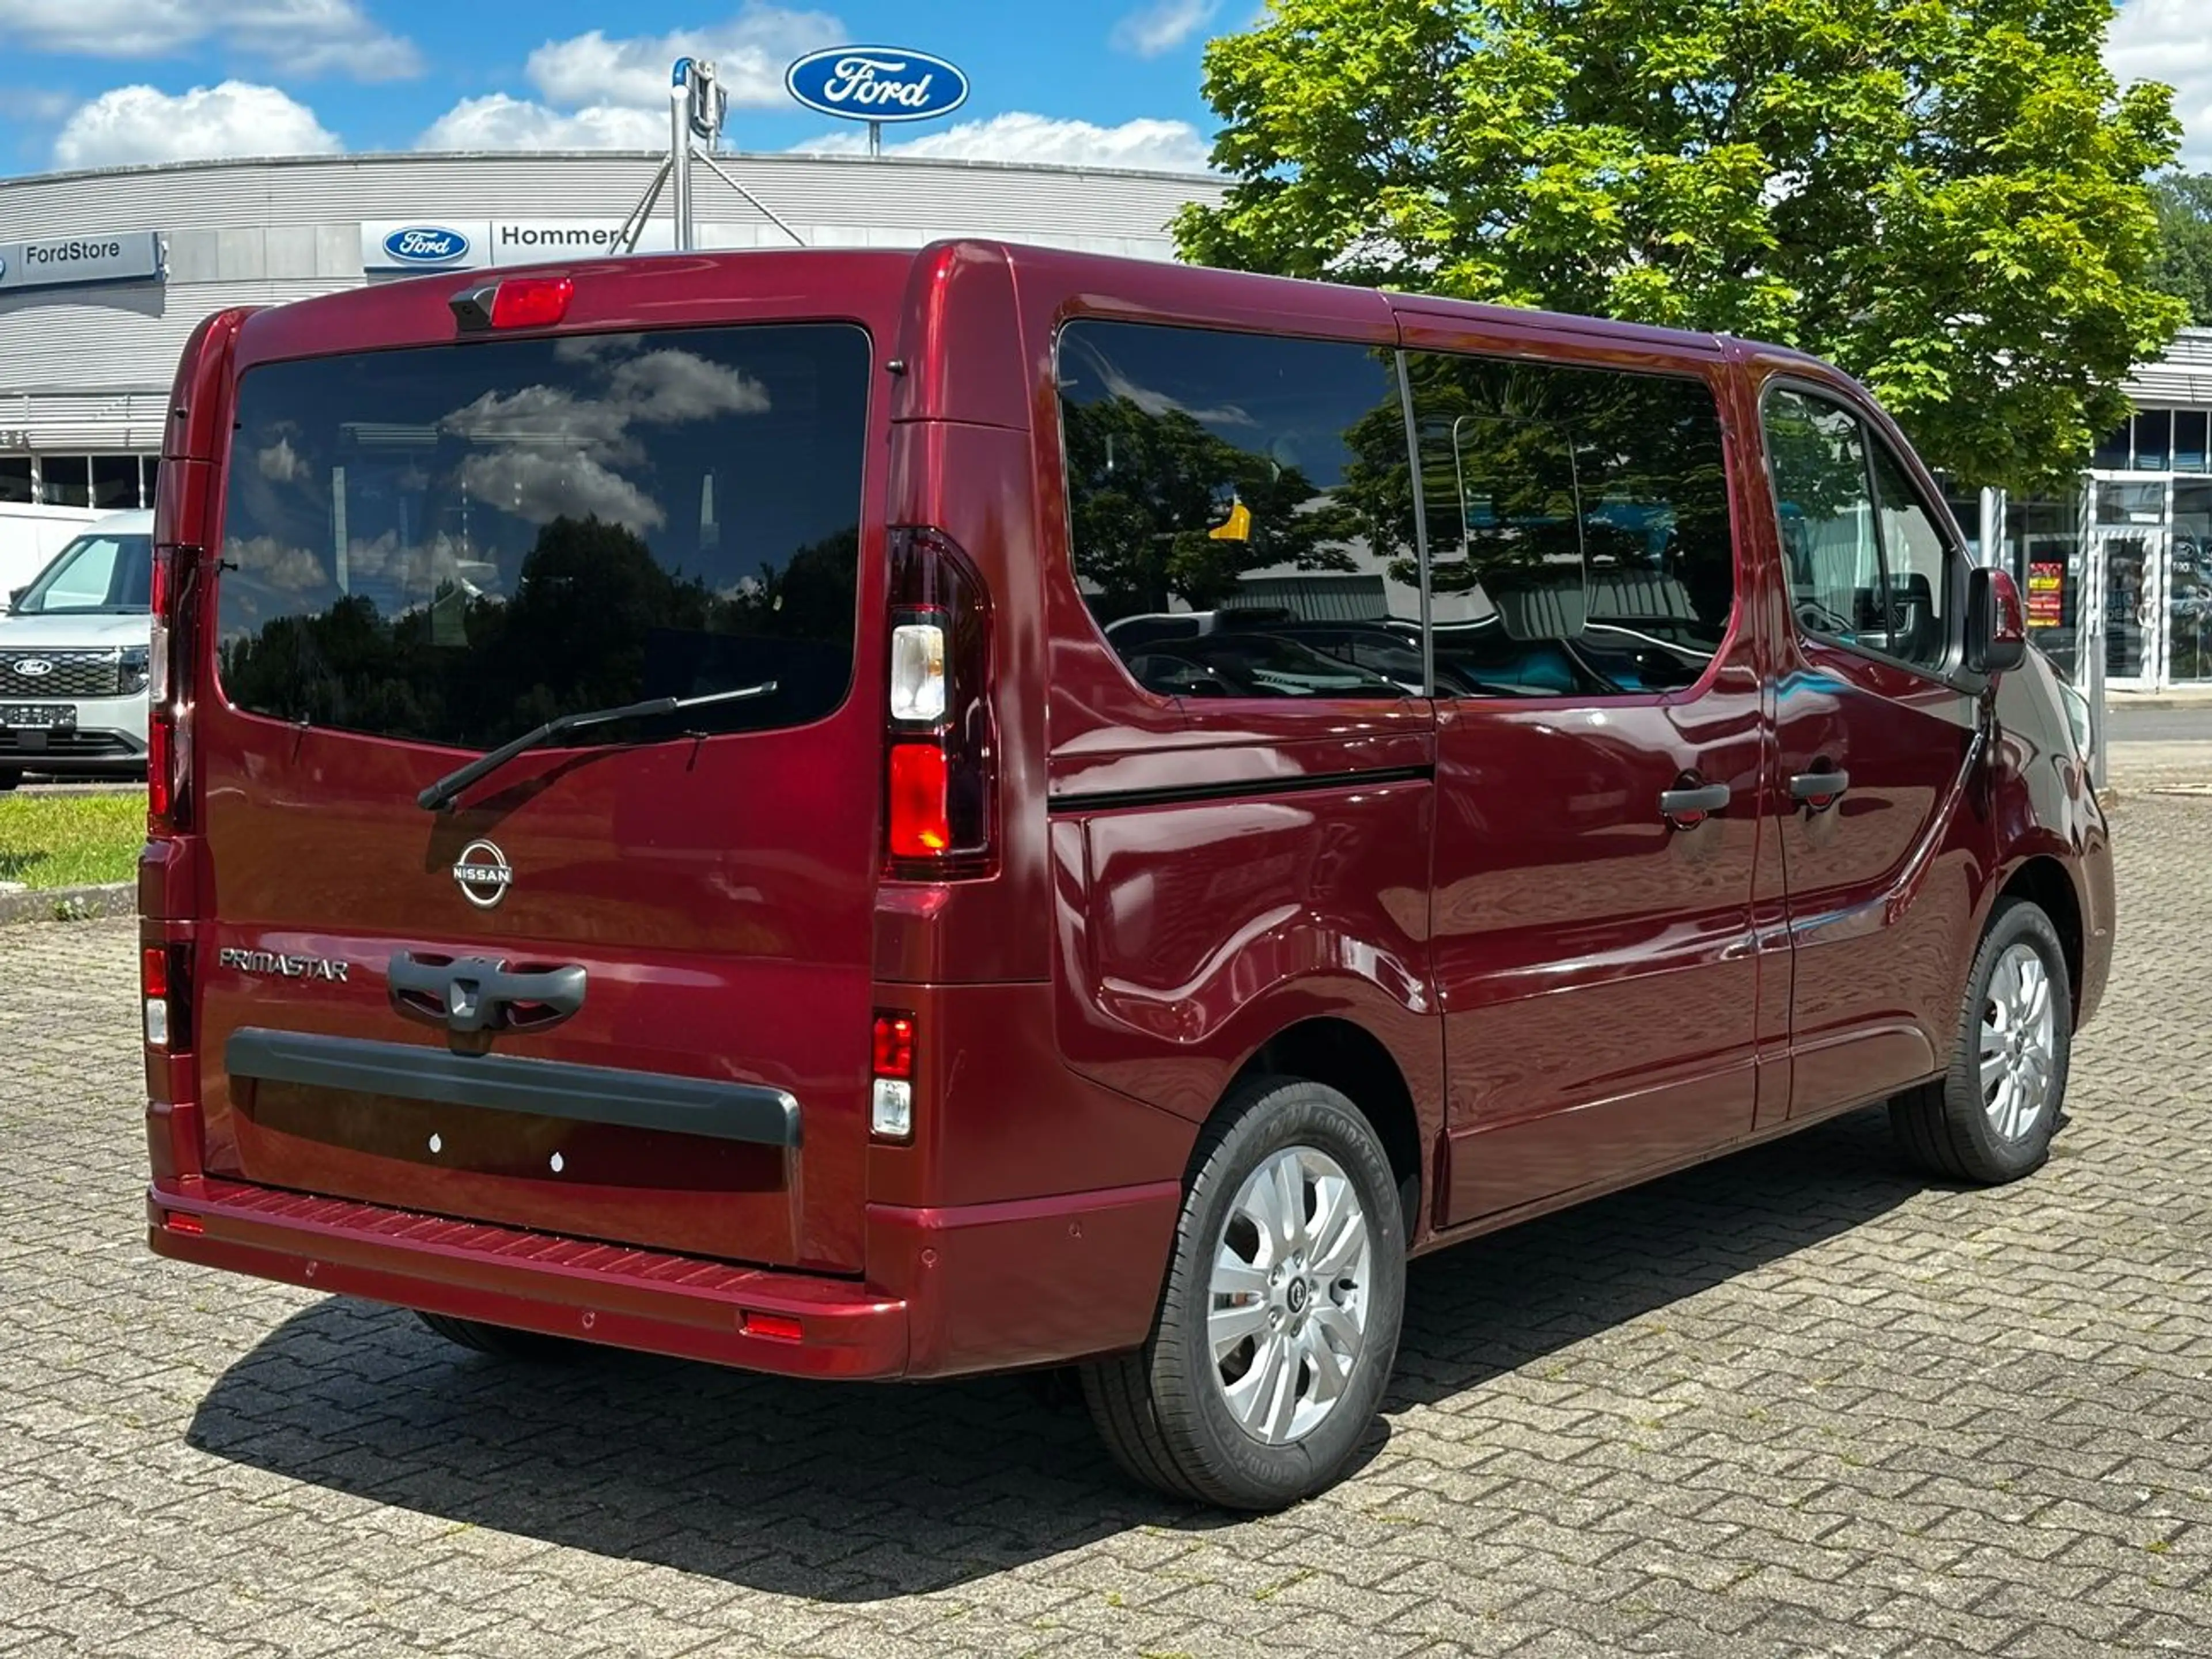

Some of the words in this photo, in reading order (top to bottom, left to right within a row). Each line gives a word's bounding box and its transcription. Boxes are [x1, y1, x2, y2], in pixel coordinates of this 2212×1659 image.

[824, 56, 933, 107] Ford
[26, 242, 120, 264] FordStore
[399, 232, 451, 254] Ford
[453, 866, 510, 882] NISSAN
[219, 947, 348, 983] PRIMASTAR
